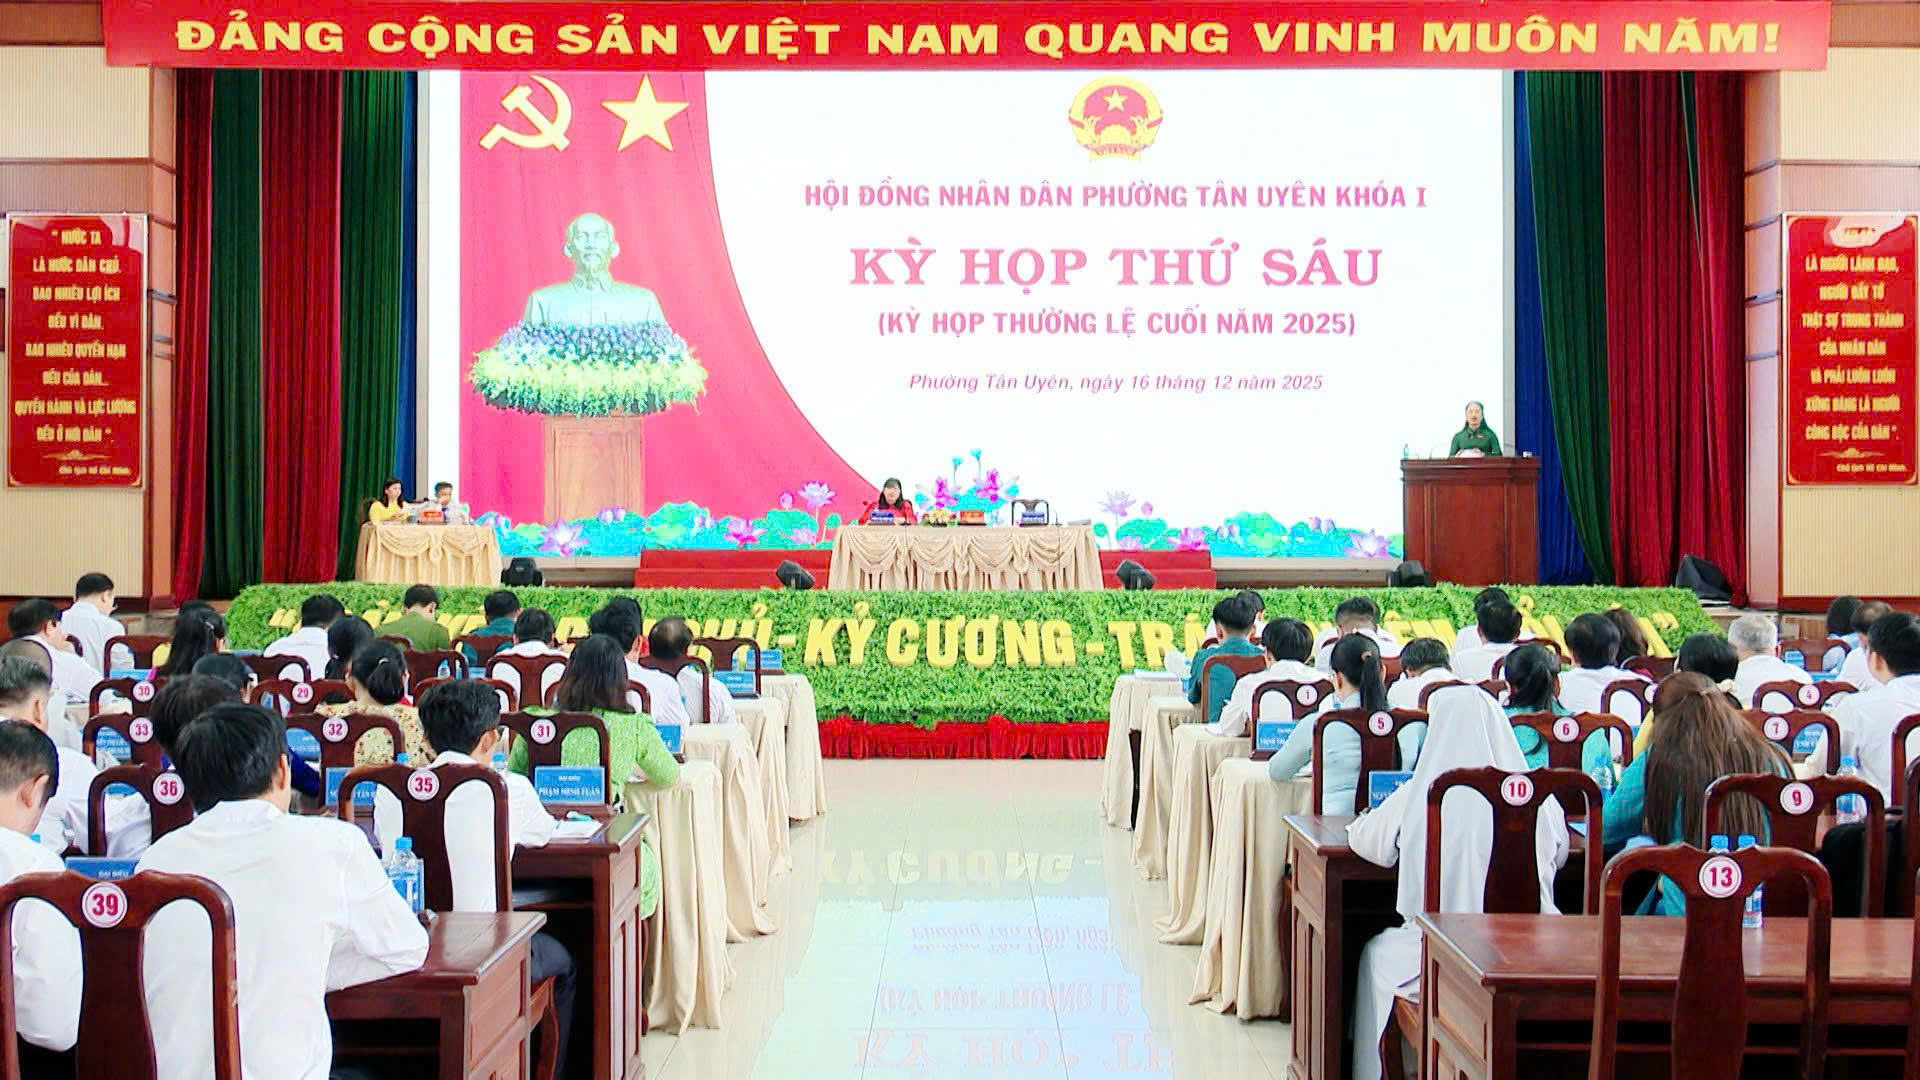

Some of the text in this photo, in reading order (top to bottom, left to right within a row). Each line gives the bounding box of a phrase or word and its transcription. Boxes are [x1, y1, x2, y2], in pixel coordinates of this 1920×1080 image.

[175, 10, 1781, 60] ĐẢNG CỘNG SẢN VIỆT NAM QUANG VINH MUÔN NĂM!
[804, 176, 1427, 212] HỘI ĐỒNG NHÂN DÂN PHƯỜNG TÂN UYÊN KHÓA I
[849, 236, 1384, 296] KỲ HỌP THỨ SÁU
[878, 303, 1357, 338] (KỲ HỌP THƯỜNG LỆ CUỐI NĂM 2025)
[909, 374, 1324, 394] Phường Tân Uyên, ngày 16 tháng 12 năm 2025
[886, 614, 1077, 667] CƯƠNG
[134, 722, 149, 737] 33
[327, 722, 344, 736] 32
[536, 724, 551, 738] 31
[1376, 717, 1386, 730] 5
[1561, 722, 1571, 736] 6
[1772, 722, 1780, 736] 7
[159, 779, 178, 797] 36
[414, 776, 434, 793] 35
[1508, 780, 1528, 798] 10
[1791, 789, 1803, 807] 9
[1708, 867, 1733, 888] 13
[90, 892, 119, 917] 39
